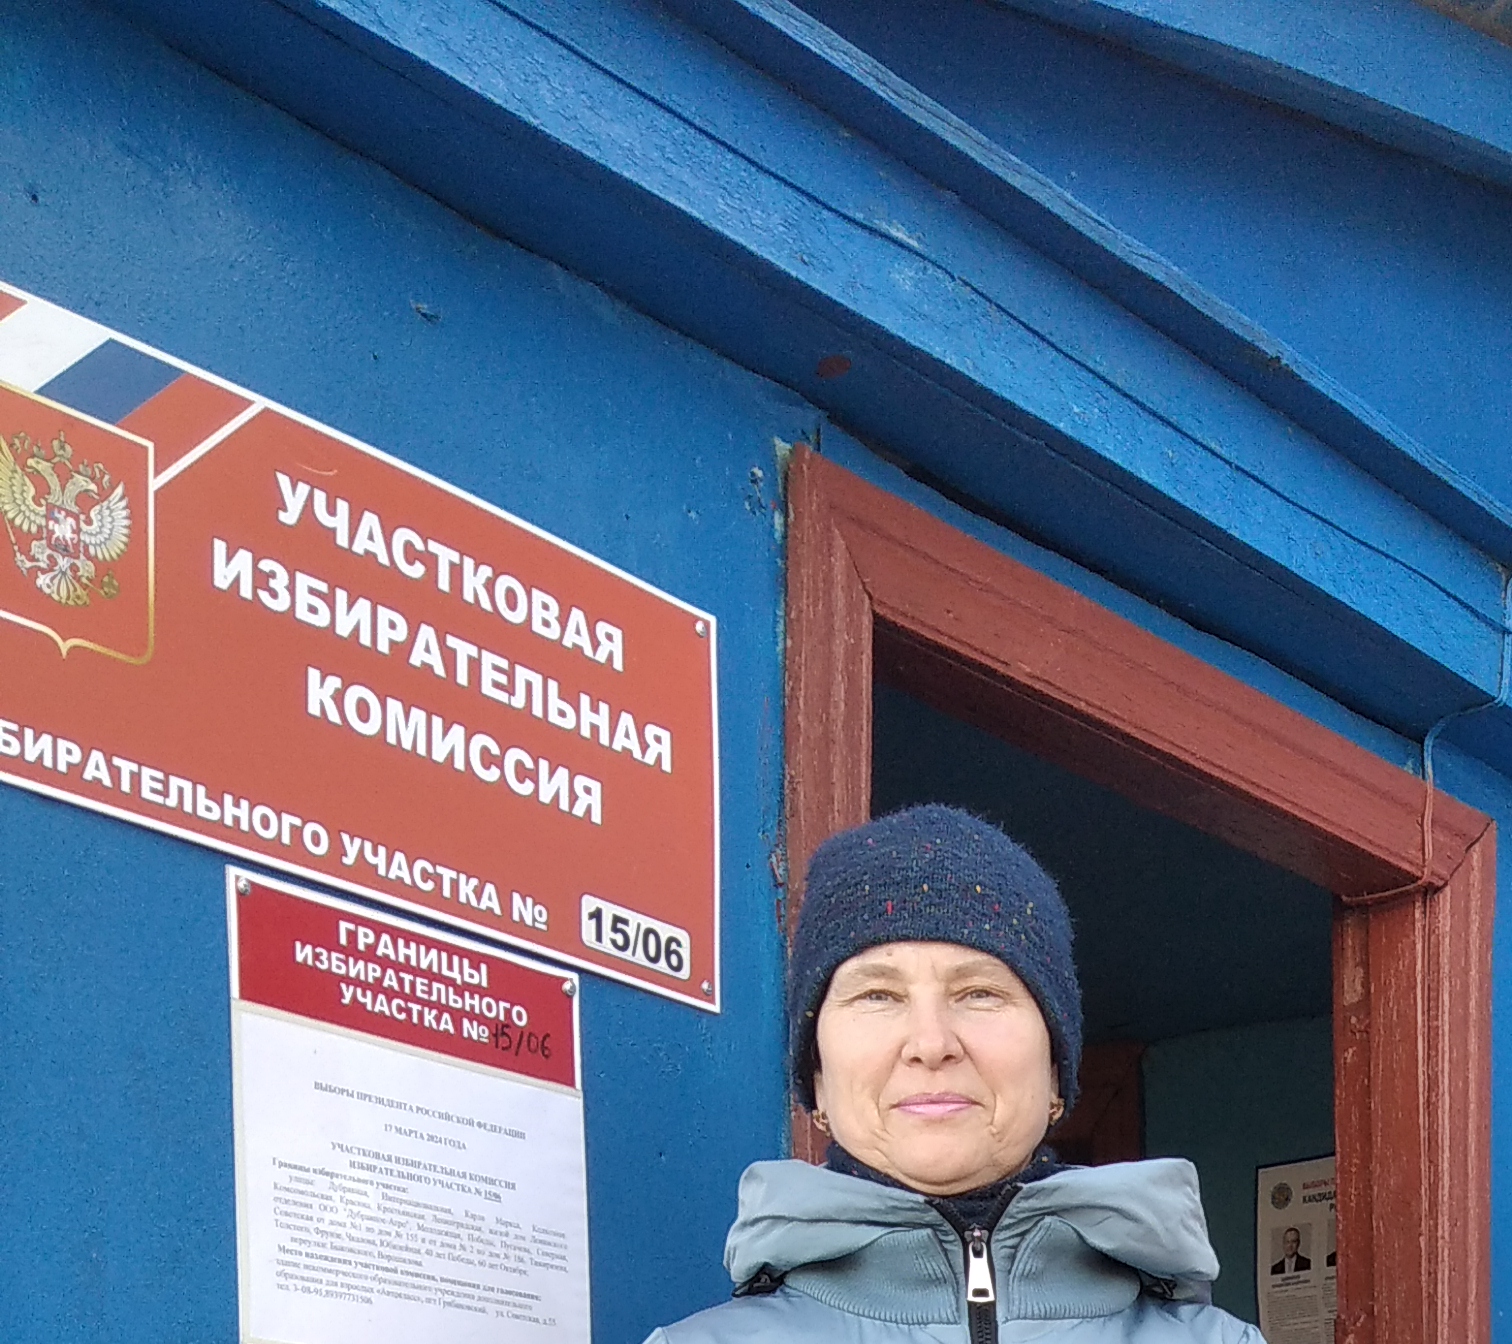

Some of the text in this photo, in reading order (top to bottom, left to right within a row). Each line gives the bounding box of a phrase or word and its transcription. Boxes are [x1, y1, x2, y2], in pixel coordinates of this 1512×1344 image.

[274, 471, 625, 672] УЧАСТКОВАЯ
[211, 537, 673, 773] ИЗБИРАТЕЛЬНАЯ
[306, 665, 603, 826] КОМИССИЯ
[339, 831, 502, 916] УЧАСТКА
[511, 891, 548, 931] №
[587, 906, 685, 974] 15/06
[293, 941, 528, 1027] ИЗБИРАТЕЛЬНОГО
[338, 919, 489, 988] ГРАНИЦЫ
[339, 982, 490, 1044] УЧАСТКА №
[491, 1024, 552, 1059] 15/06
[314, 1081, 354, 1098] ВЫБОРЫ
[357, 1092, 413, 1112] ПРЕЗИДЕНТА
[416, 1106, 474, 1127] РОССИЙСКОЙ
[384, 1124, 392, 1132] 17
[394, 1126, 424, 1140] МАРТА
[331, 1142, 392, 1162] УЧАСТКОВАЯ
